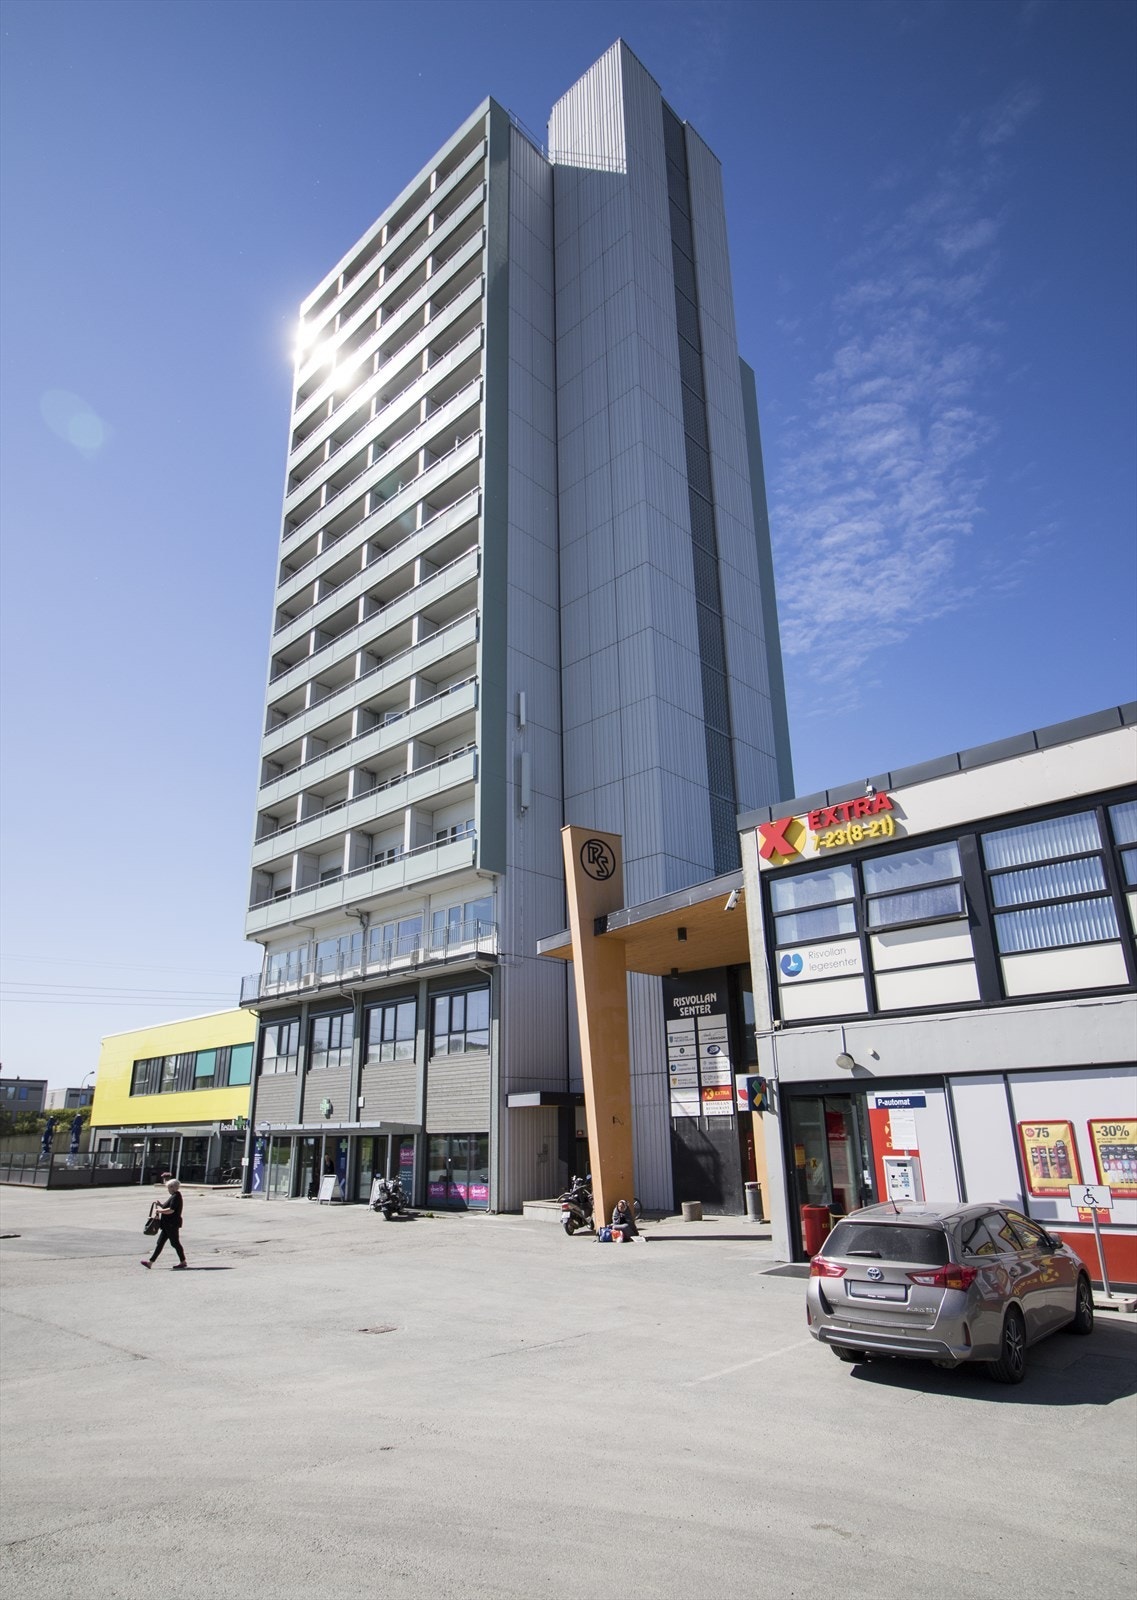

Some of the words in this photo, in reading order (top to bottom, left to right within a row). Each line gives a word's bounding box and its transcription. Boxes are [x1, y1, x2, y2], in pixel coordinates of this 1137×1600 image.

[807, 792, 893, 831] EXTRA
[808, 946, 846, 960] Risvollan
[808, 957, 857, 972] legesenter
[673, 992, 717, 1008] RISVOLLAN
[679, 1004, 711, 1017] SENTER
[714, 1089, 730, 1097] EXTRA
[877, 1098, 911, 1107] P-automat
[1036, 1127, 1049, 1137] 75
[1096, 1125, 1130, 1137] -30%
